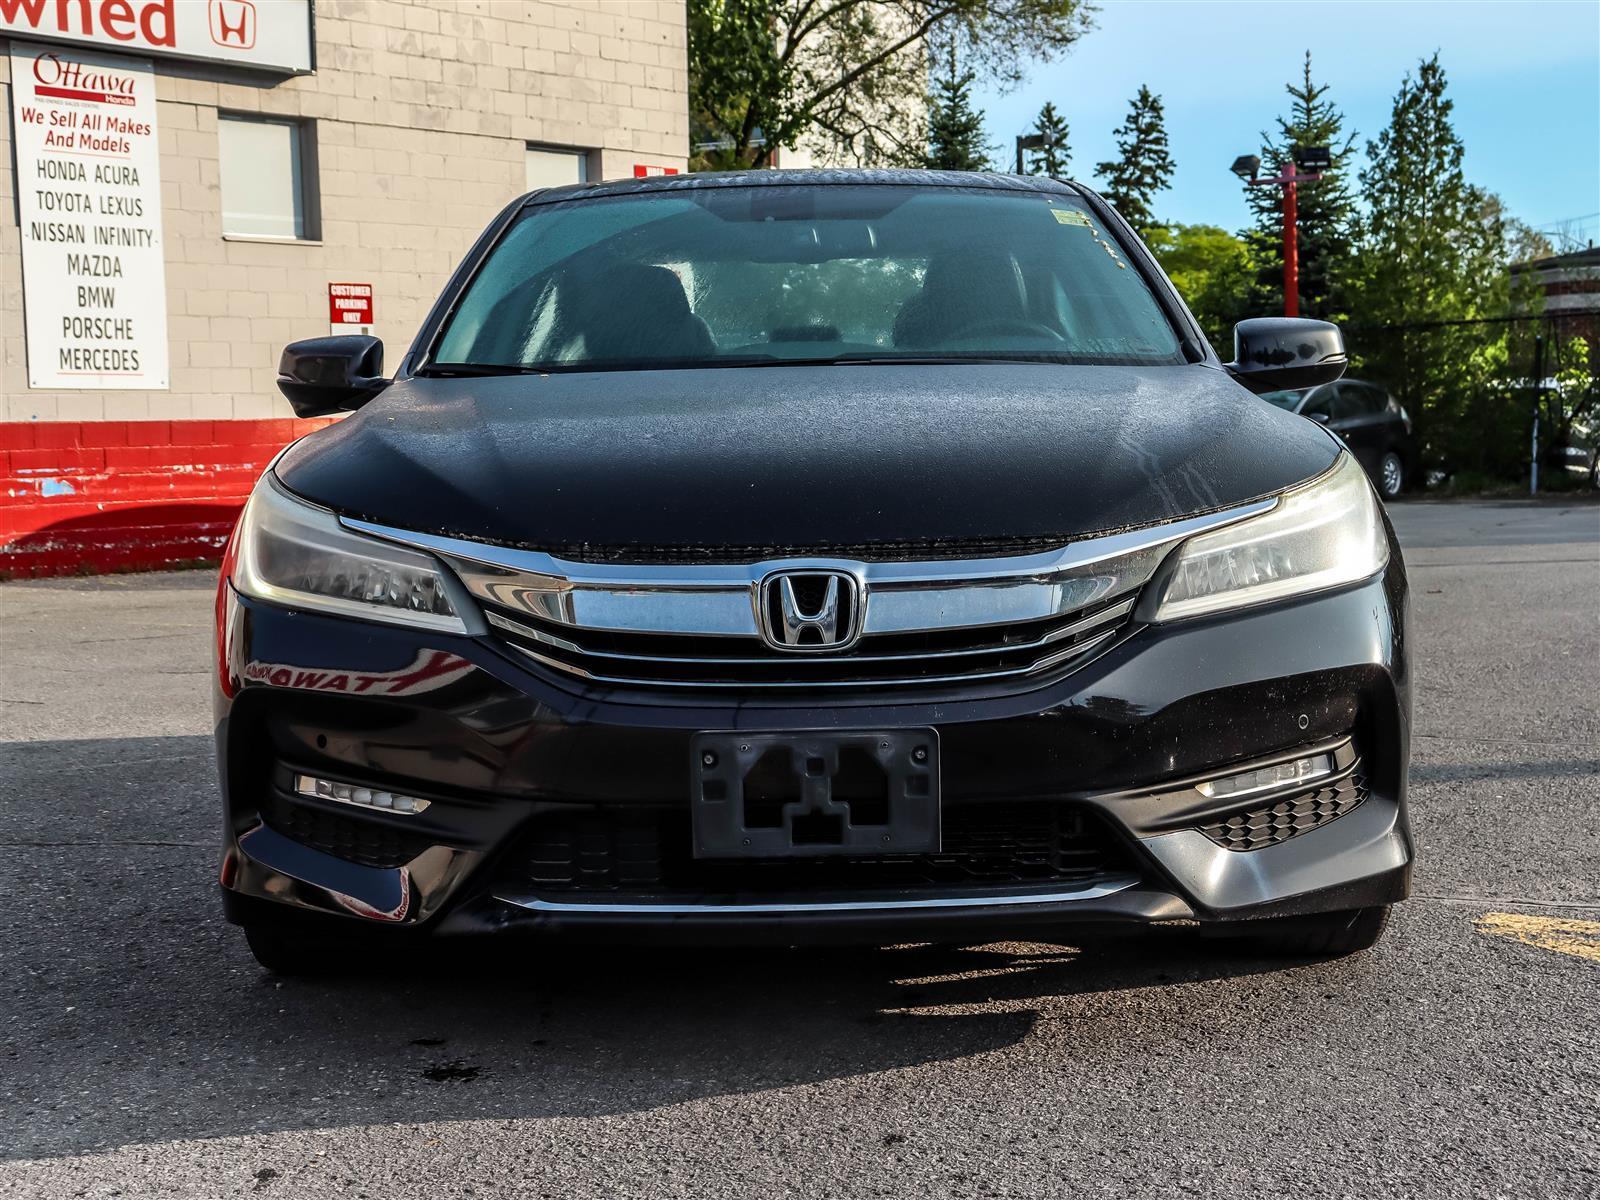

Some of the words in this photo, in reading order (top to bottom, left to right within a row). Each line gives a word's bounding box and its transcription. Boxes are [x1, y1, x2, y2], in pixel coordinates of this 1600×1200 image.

[33, 52, 136, 94] Ottawa
[105, 94, 136, 106] Honda
[21, 106, 44, 124] We
[50, 110, 77, 128] Sell
[82, 114, 101, 131] All
[107, 117, 151, 136] Makes
[45, 130, 74, 148] And
[80, 134, 131, 153] Models
[36, 159, 87, 182] HONDA
[94, 165, 140, 186] ACURA
[36, 190, 92, 213] TOYOTA
[100, 196, 143, 217] LEXUS
[31, 221, 85, 244] NISSAN
[94, 226, 153, 248] INFINITY
[67, 253, 123, 278] MAZDA
[77, 286, 115, 309] BMW
[331, 285, 371, 296] CUSTOMER
[335, 298, 368, 310] PARKING
[63, 316, 134, 340] PORSCHE
[342, 312, 361, 323] ONLY
[59, 347, 140, 371] MERCEDES
